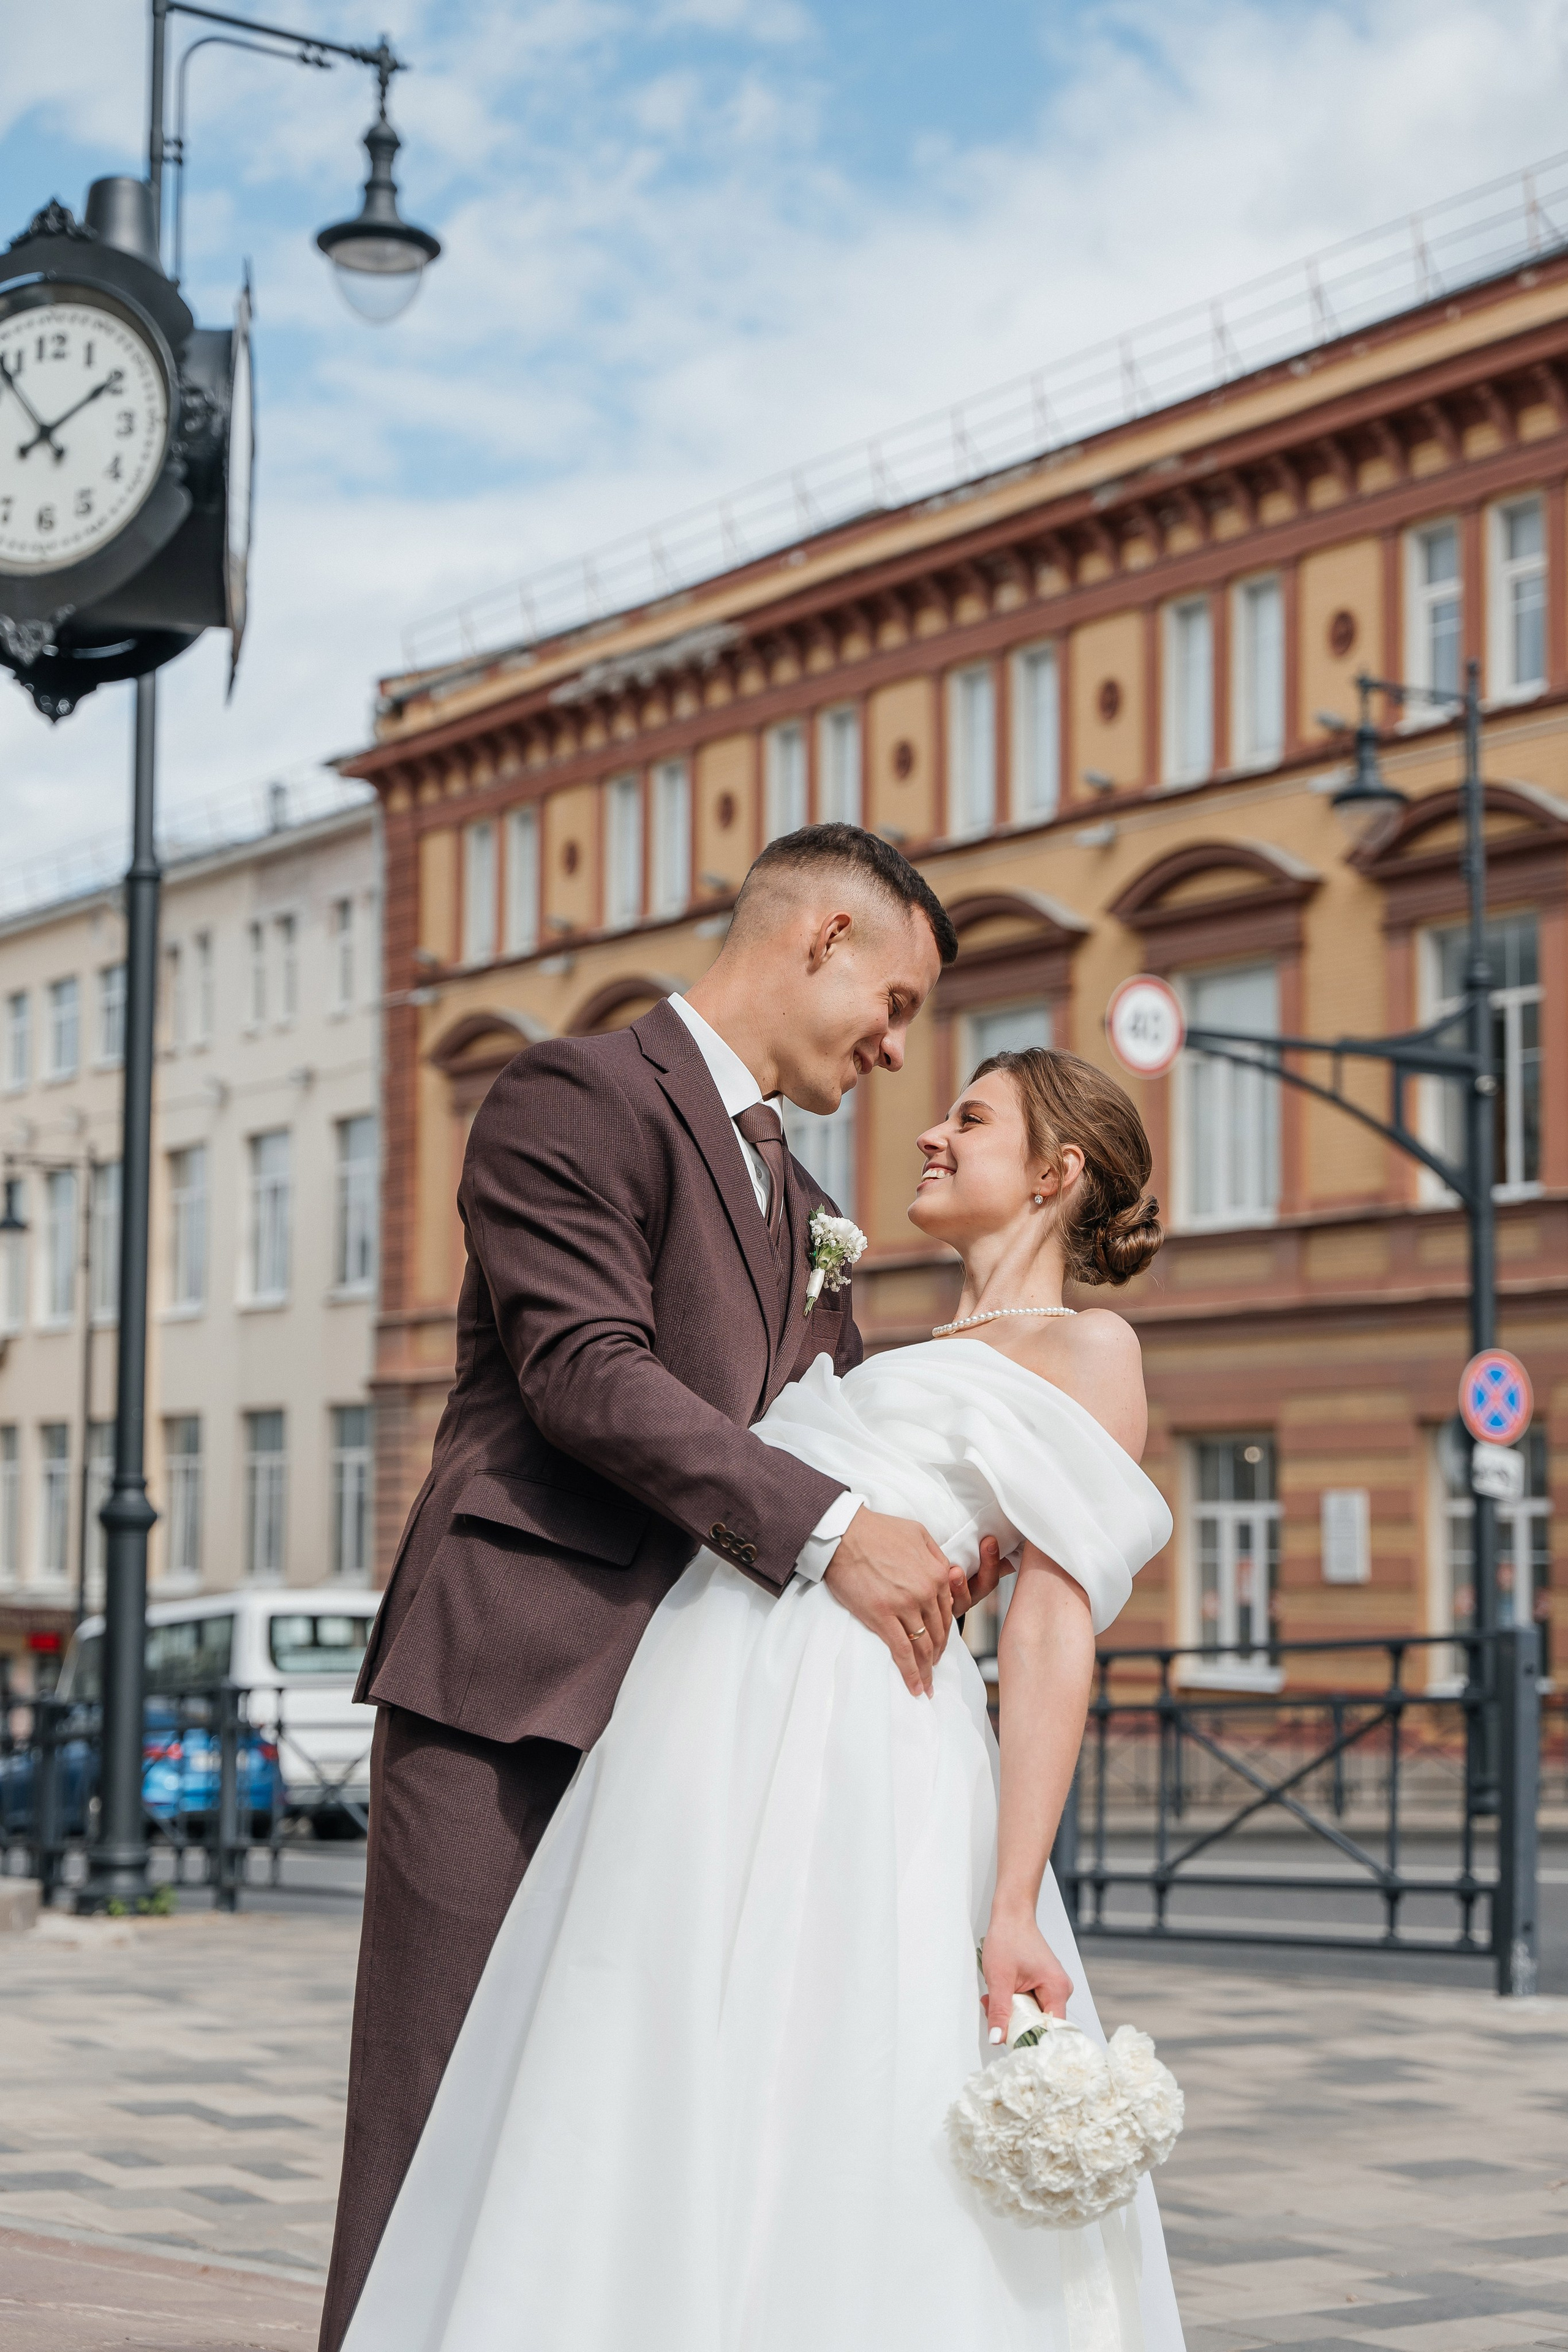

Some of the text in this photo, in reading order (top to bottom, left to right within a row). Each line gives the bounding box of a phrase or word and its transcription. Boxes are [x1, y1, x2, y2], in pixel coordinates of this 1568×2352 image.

[37, 335, 66, 360] 12
[86, 341, 92, 366] 1
[118, 410, 134, 436] 3
[104, 456, 121, 480] 4
[75, 488, 91, 515] 5
[37, 507, 55, 530] 6
